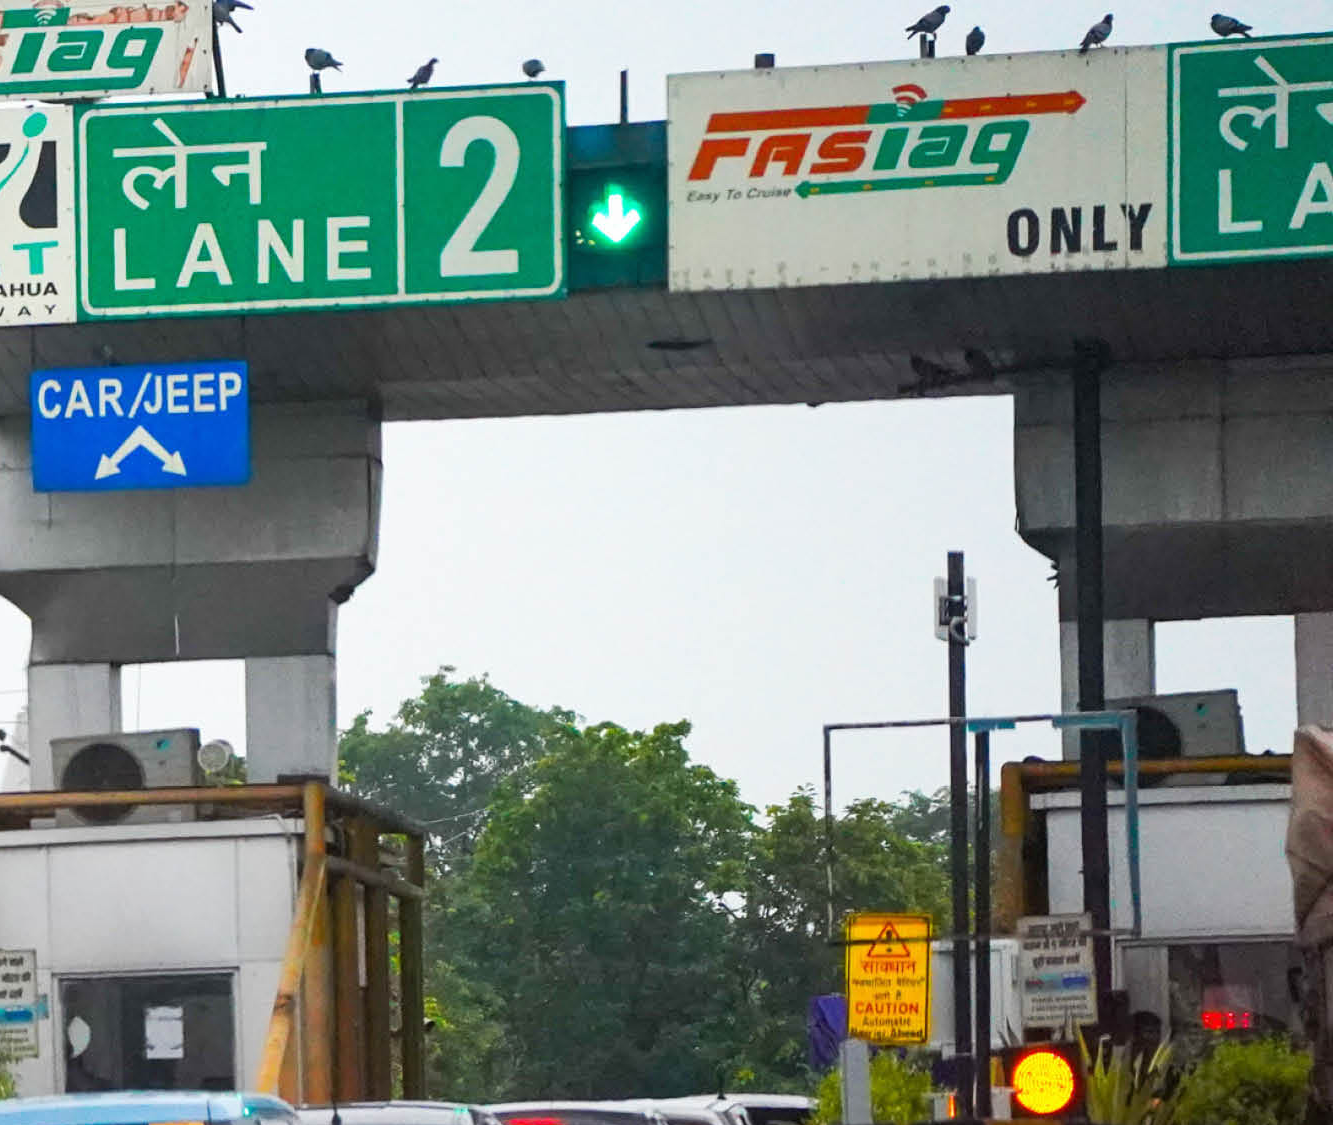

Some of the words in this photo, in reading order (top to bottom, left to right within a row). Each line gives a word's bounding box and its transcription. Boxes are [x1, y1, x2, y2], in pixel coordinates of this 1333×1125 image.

[1218, 55, 1333, 151] ले
[112, 118, 267, 212] लेन
[437, 116, 520, 279] 2
[685, 189, 723, 205] Easy
[725, 188, 743, 201] To
[745, 186, 793, 201] Cruise
[113, 215, 372, 291] LANE
[1006, 202, 1153, 257] ONLY
[37, 371, 243, 419] CAR/JEEP
[854, 1001, 920, 1016] CAUTION
